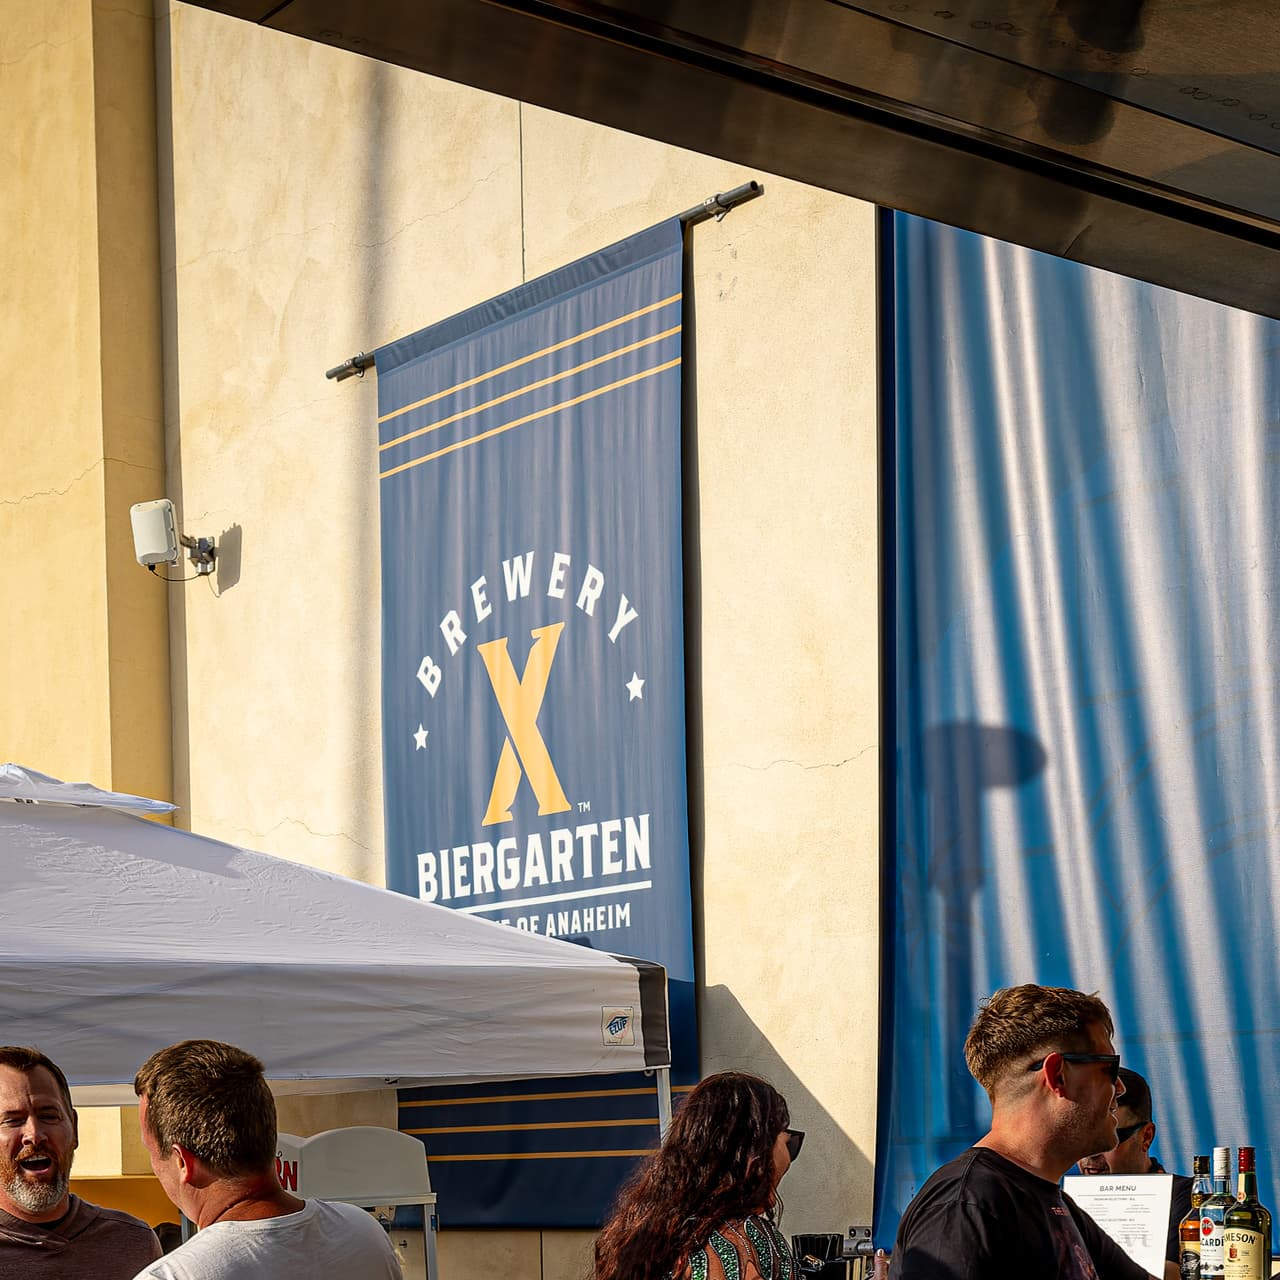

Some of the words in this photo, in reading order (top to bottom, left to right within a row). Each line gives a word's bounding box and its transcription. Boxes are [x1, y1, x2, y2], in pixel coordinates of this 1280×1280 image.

[416, 550, 639, 698] BREWERY
[477, 621, 572, 827] X
[416, 813, 652, 903] BIERGARTEN
[545, 902, 631, 937] ANAHEIM
[1201, 1236, 1225, 1248] CARD
[1223, 1232, 1256, 1245] MESON
